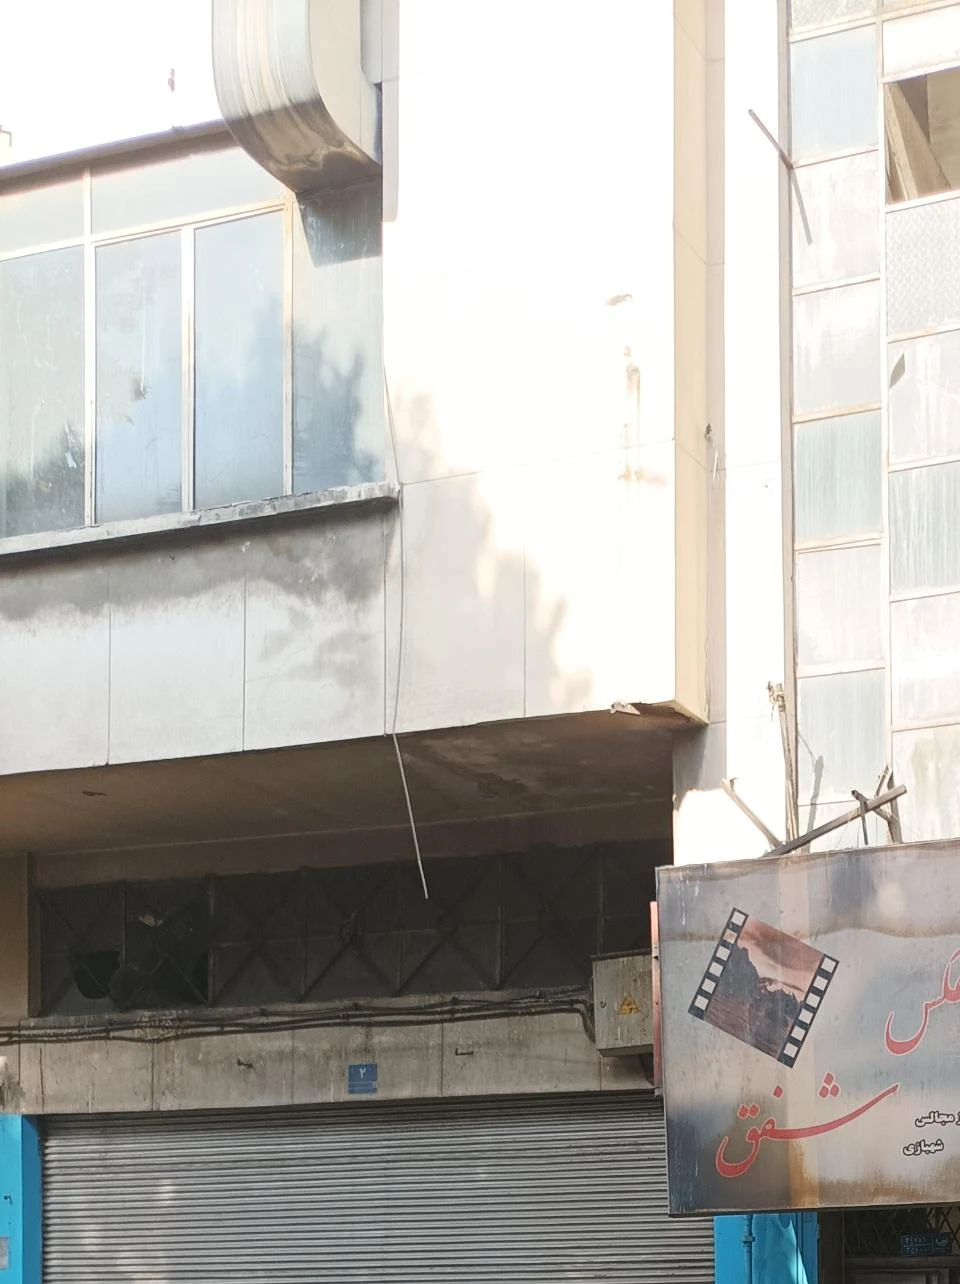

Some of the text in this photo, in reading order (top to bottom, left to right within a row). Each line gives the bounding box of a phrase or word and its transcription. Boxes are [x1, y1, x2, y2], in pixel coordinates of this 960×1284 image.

[715, 1071, 900, 1178] شفق
[914, 1110, 955, 1128] مجالس
[903, 1138, 944, 1156] شهبازی
